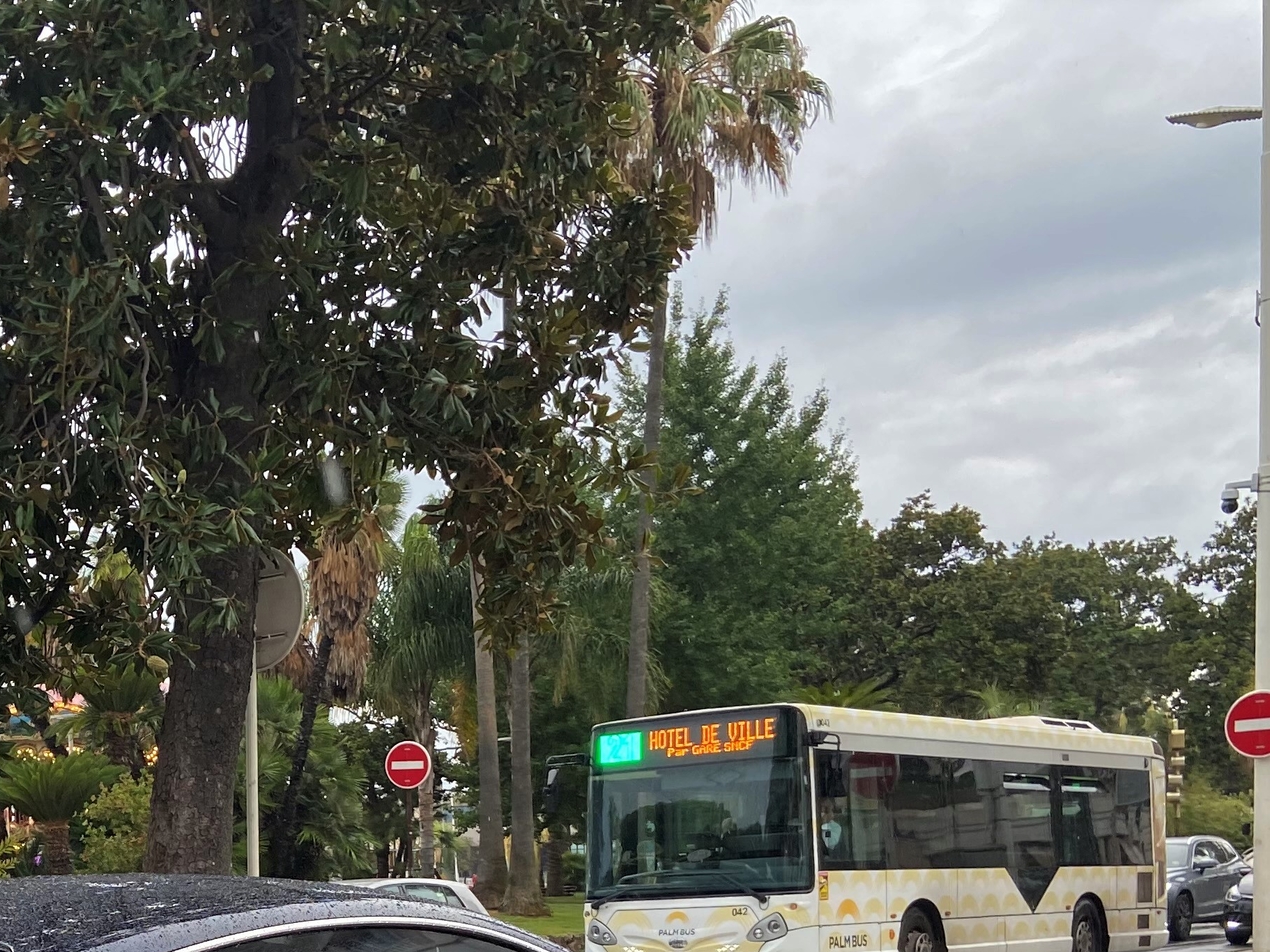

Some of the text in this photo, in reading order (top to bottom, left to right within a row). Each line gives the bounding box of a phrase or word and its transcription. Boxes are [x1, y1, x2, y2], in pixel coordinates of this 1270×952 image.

[649, 717, 777, 750] HOTEL DE VILLE
[692, 743, 721, 756] GARE
[724, 740, 753, 752] SNCF
[731, 907, 748, 917] 042
[680, 928, 696, 936] BUS
[829, 934, 868, 949] PALM BUS
